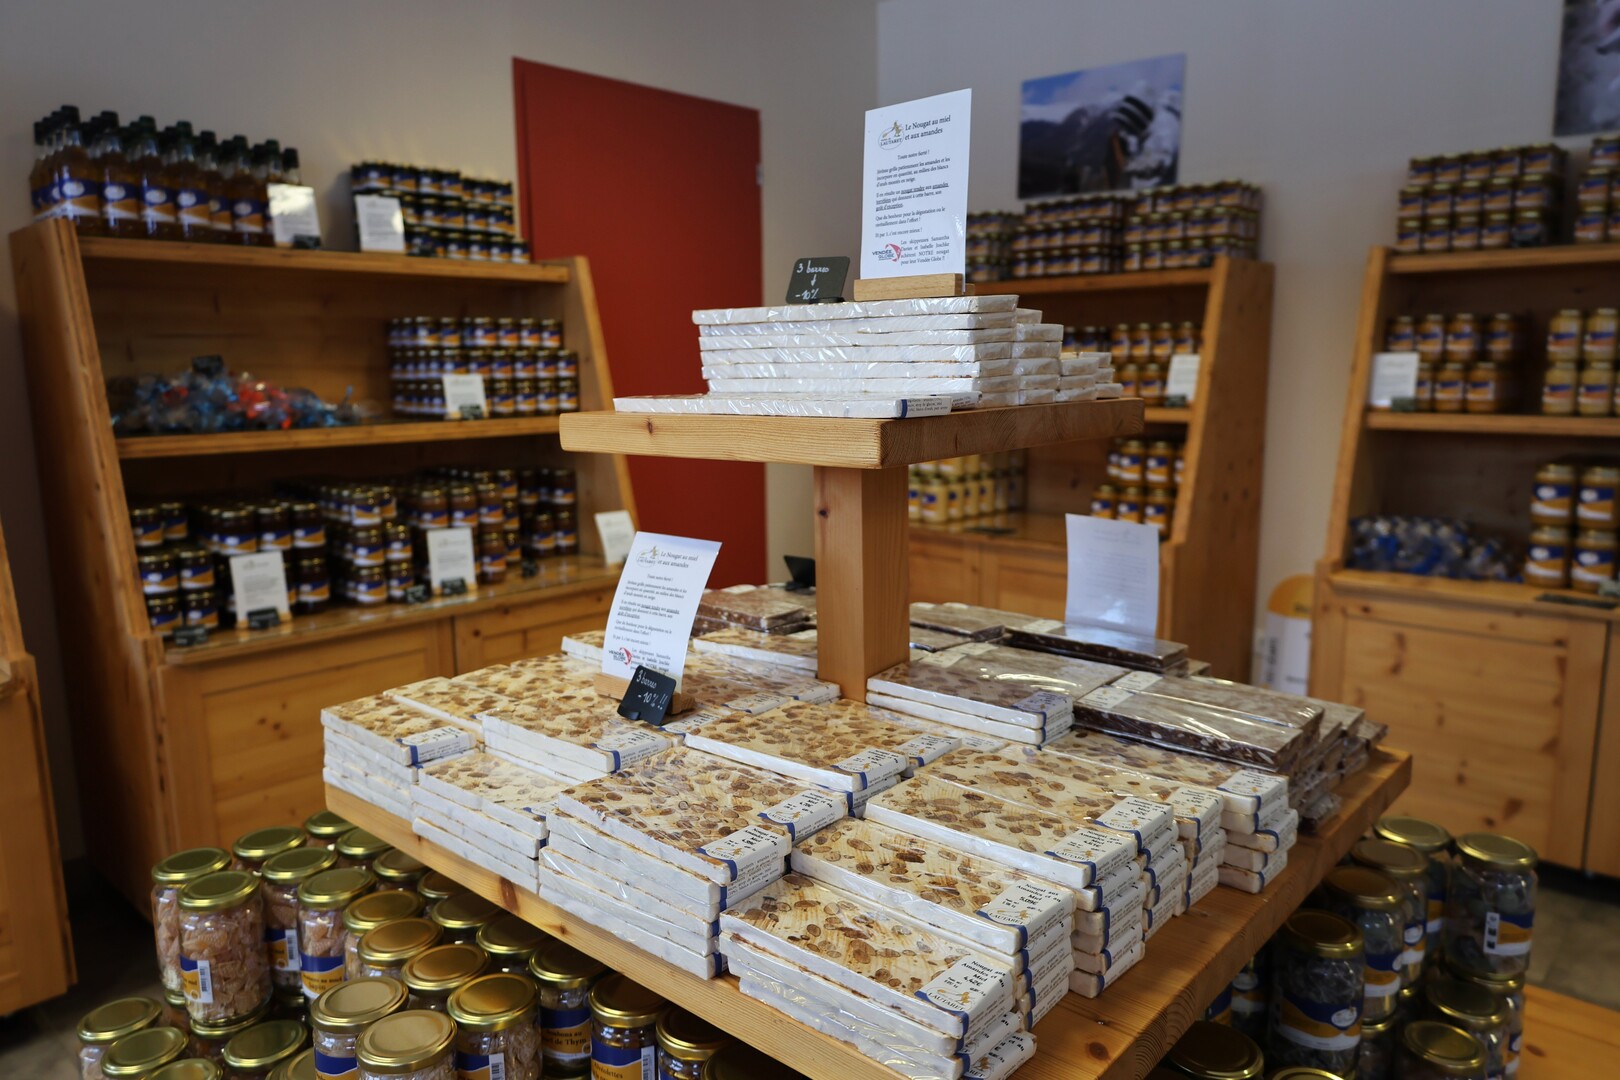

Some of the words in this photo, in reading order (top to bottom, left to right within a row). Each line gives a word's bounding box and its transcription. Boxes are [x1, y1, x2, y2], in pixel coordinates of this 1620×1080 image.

[912, 120, 931, 129] Nougat
[939, 115, 951, 123] miel
[921, 127, 943, 137] amandes
[880, 138, 902, 146] LAUTARET
[796, 263, 803, 273] 3
[806, 260, 829, 273] barres
[795, 288, 819, 300] -10%
[636, 670, 643, 682] 3
[641, 672, 657, 688] barres
[1079, 832, 1105, 842] Amandes
[1016, 885, 1043, 897] Amandes
[1026, 883, 1046, 893] Nougat
[989, 912, 1024, 924] LAUTARET
[961, 962, 988, 976] Amandes
[971, 960, 993, 972] Nougat
[963, 976, 983, 987] 4,42€
[973, 974, 988, 982] Miel
[928, 992, 964, 1010] LAUTARET
